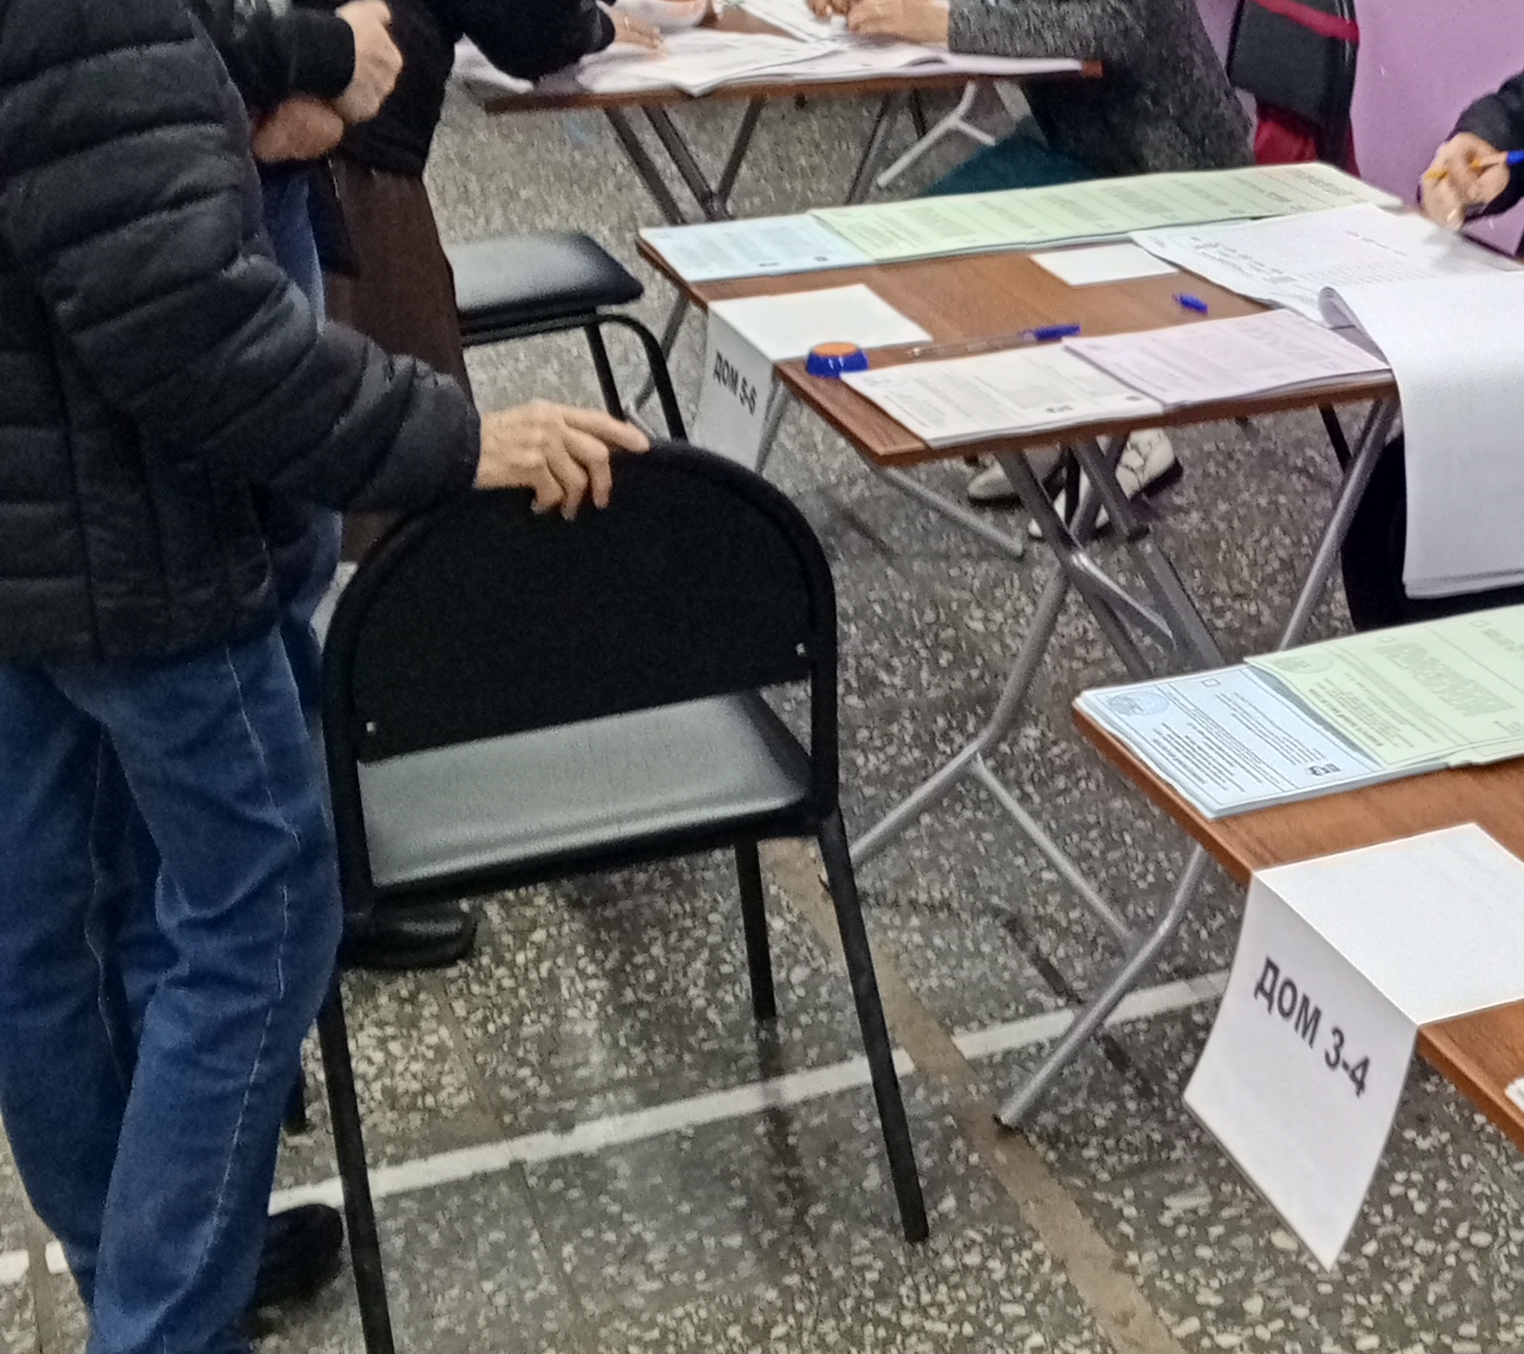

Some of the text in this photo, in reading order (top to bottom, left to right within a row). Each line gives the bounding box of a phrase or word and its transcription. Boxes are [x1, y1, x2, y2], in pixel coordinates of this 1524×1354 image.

[713, 350, 738, 398] ДОМ
[1253, 954, 1370, 1099] ДОМ 3-4
